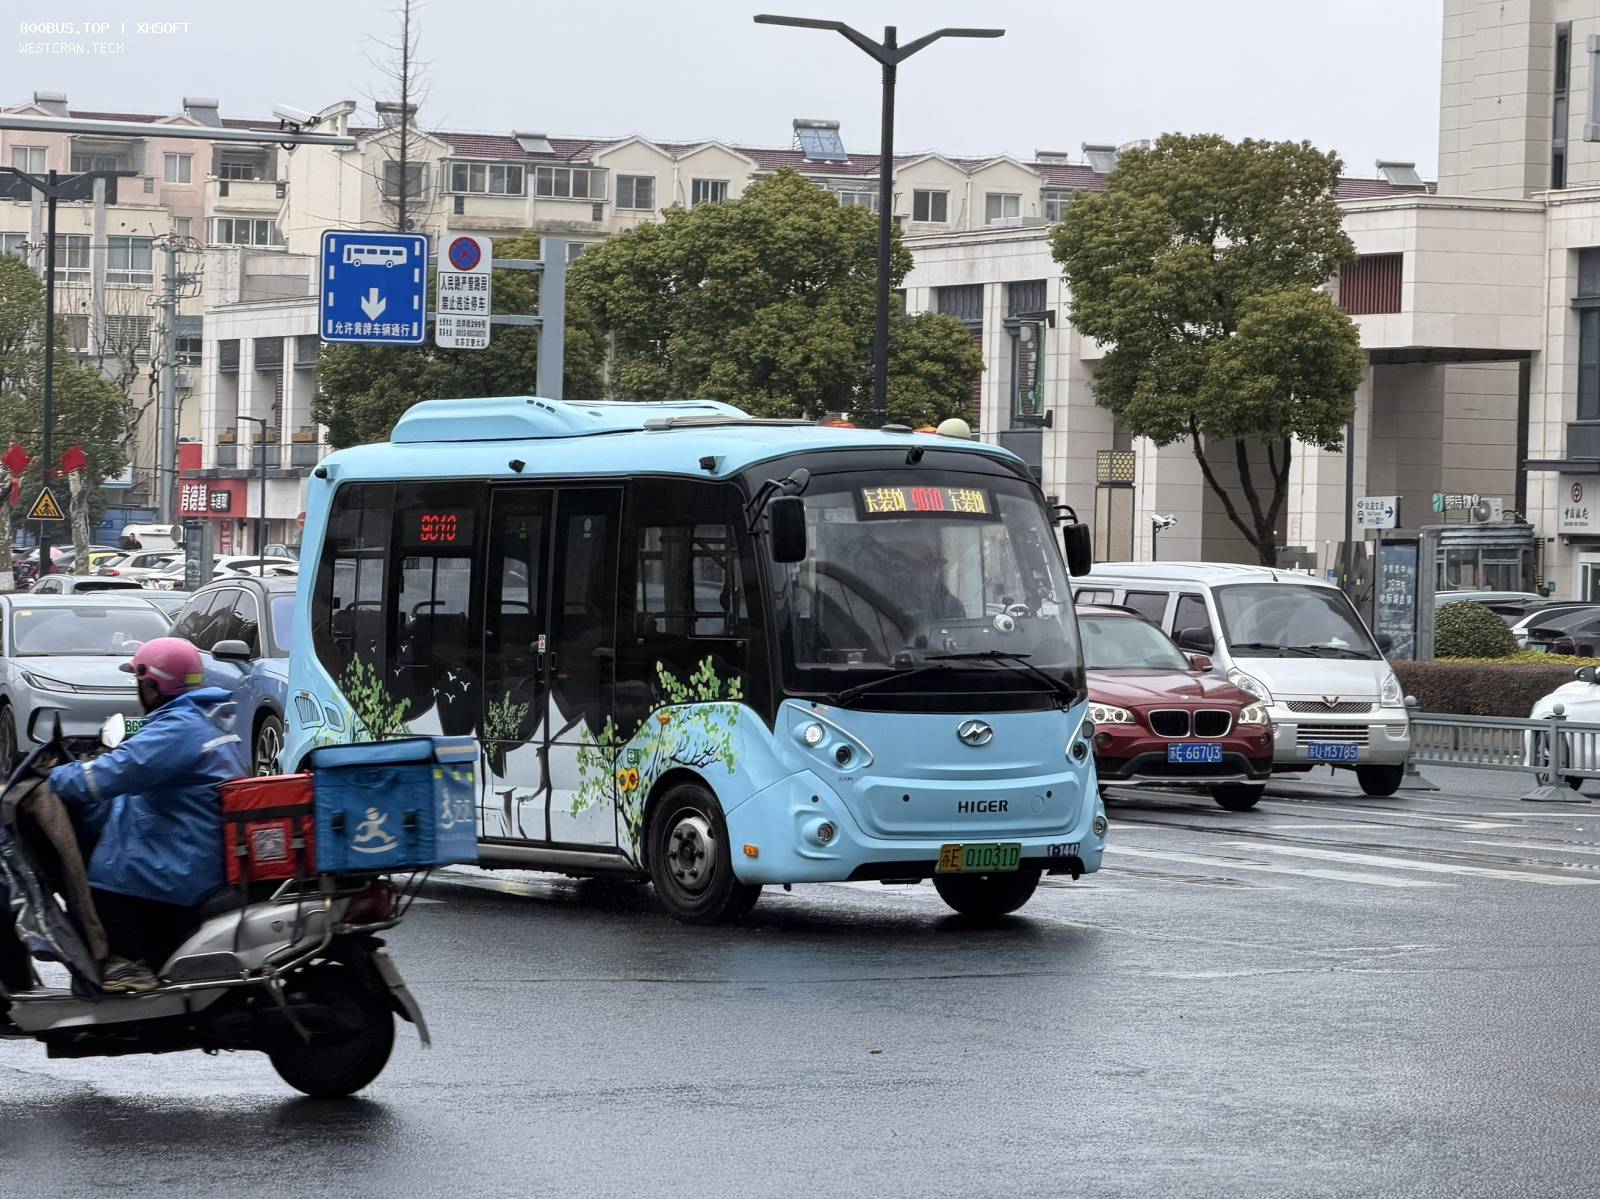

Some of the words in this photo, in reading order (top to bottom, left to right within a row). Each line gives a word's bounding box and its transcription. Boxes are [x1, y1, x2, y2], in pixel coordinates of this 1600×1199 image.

[334, 321, 410, 337] 允许黄牌车辆通行
[181, 484, 208, 511] 肯德基
[958, 799, 1008, 813] HIGER
